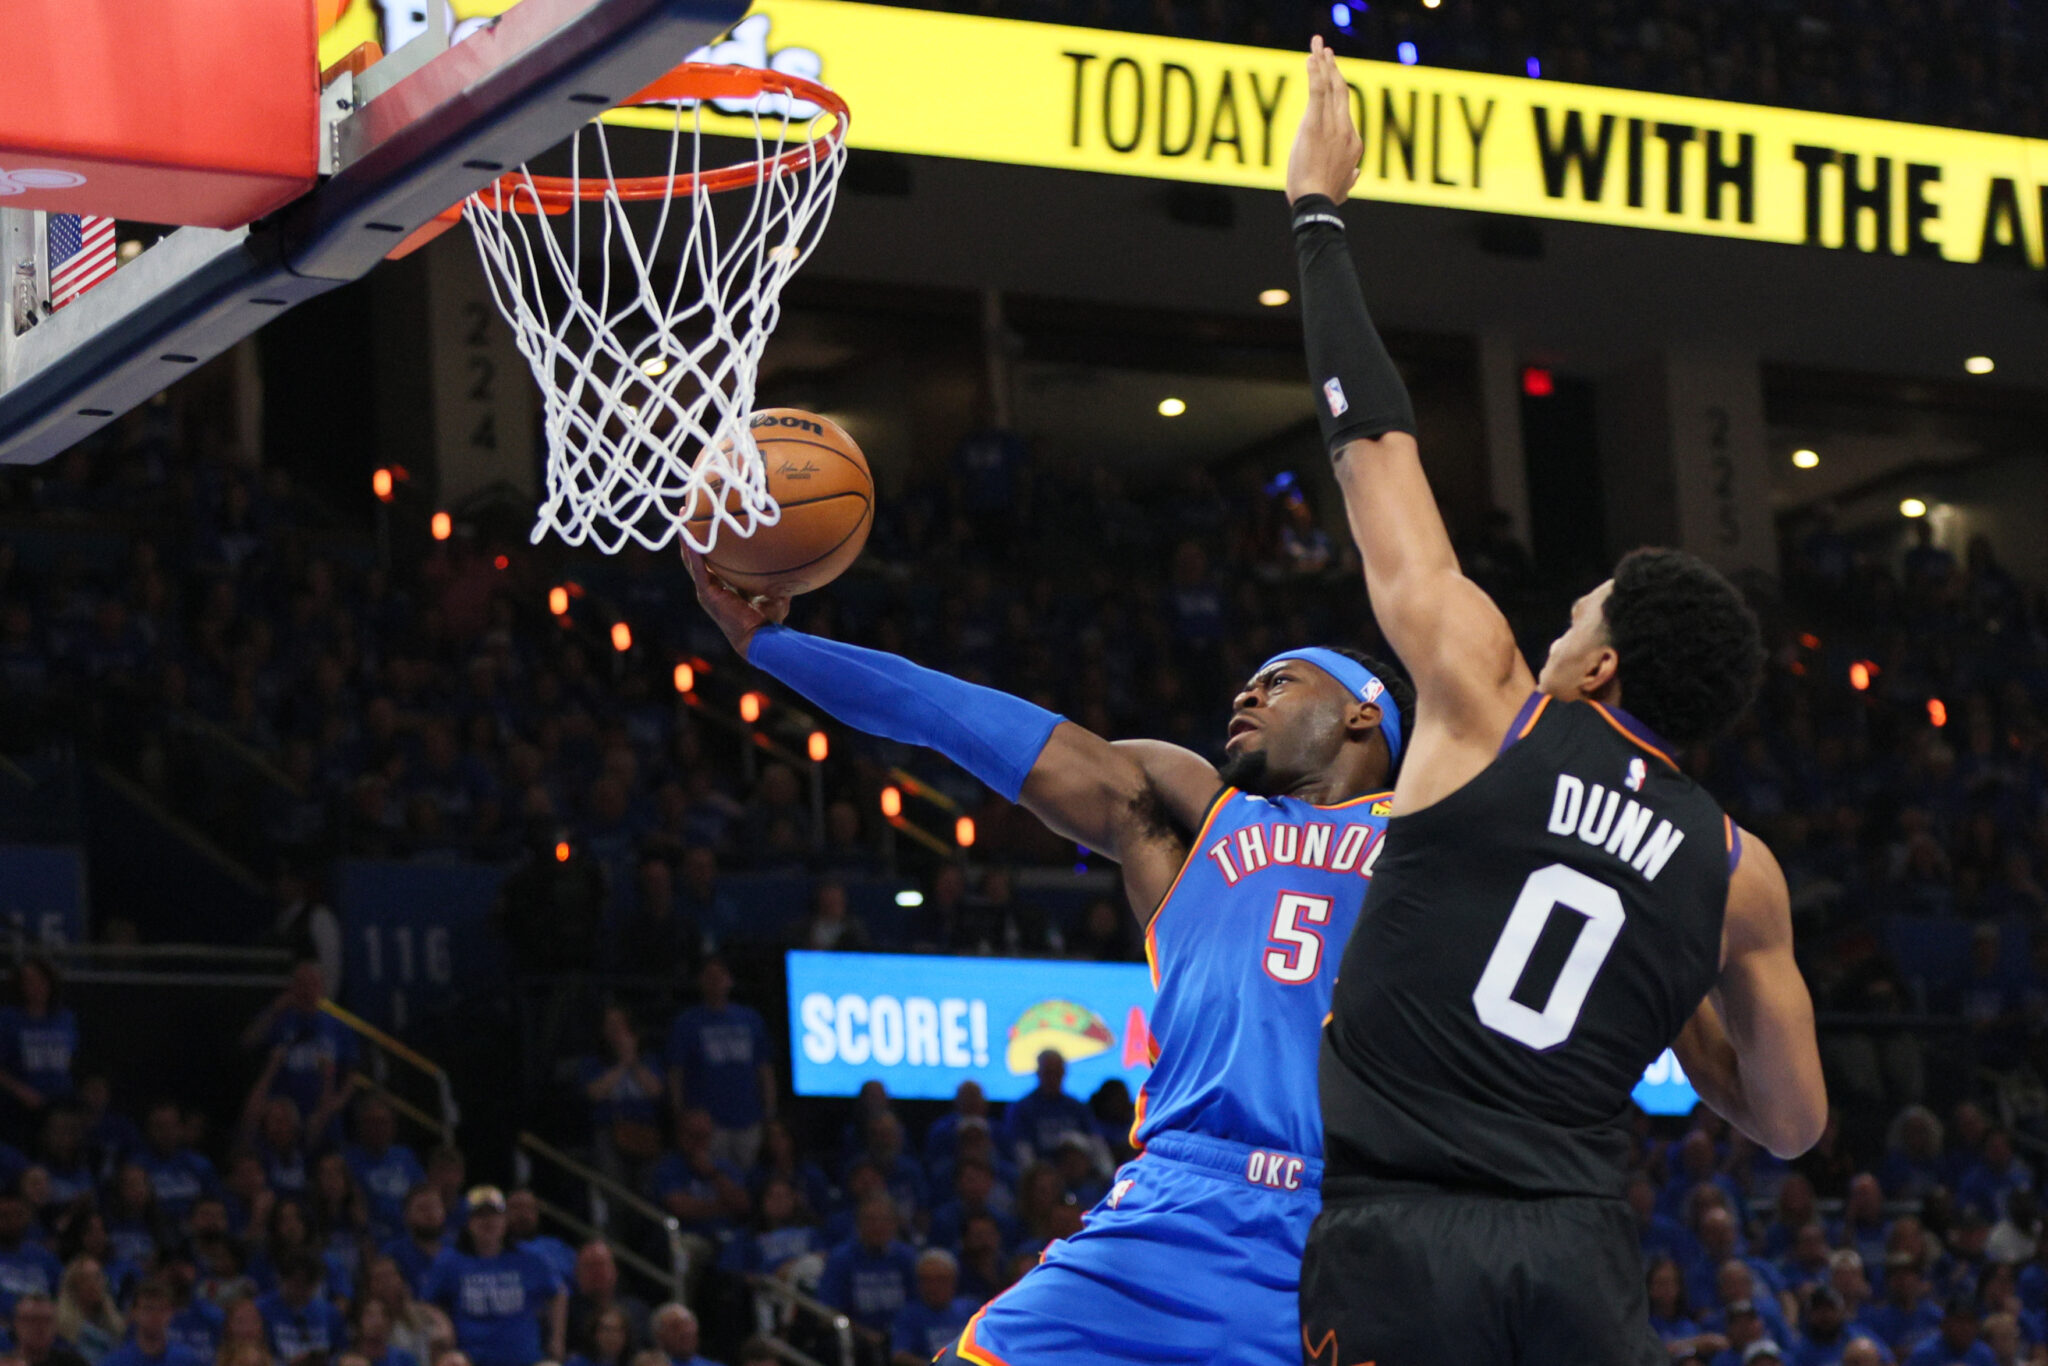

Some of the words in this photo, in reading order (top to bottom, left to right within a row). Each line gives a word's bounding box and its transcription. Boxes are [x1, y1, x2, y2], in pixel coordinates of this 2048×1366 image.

[1061, 51, 1288, 167] TODAY
[1531, 105, 1756, 224] WITH
[1792, 143, 1942, 259] THE
[1977, 177, 2048, 270] A
[750, 413, 824, 438] lson
[1547, 773, 1686, 882] DUNN
[1262, 888, 1335, 986] 5
[1472, 862, 1627, 1051] 0
[801, 992, 989, 1069] SCORE!
[1247, 1149, 1305, 1193] OKC
